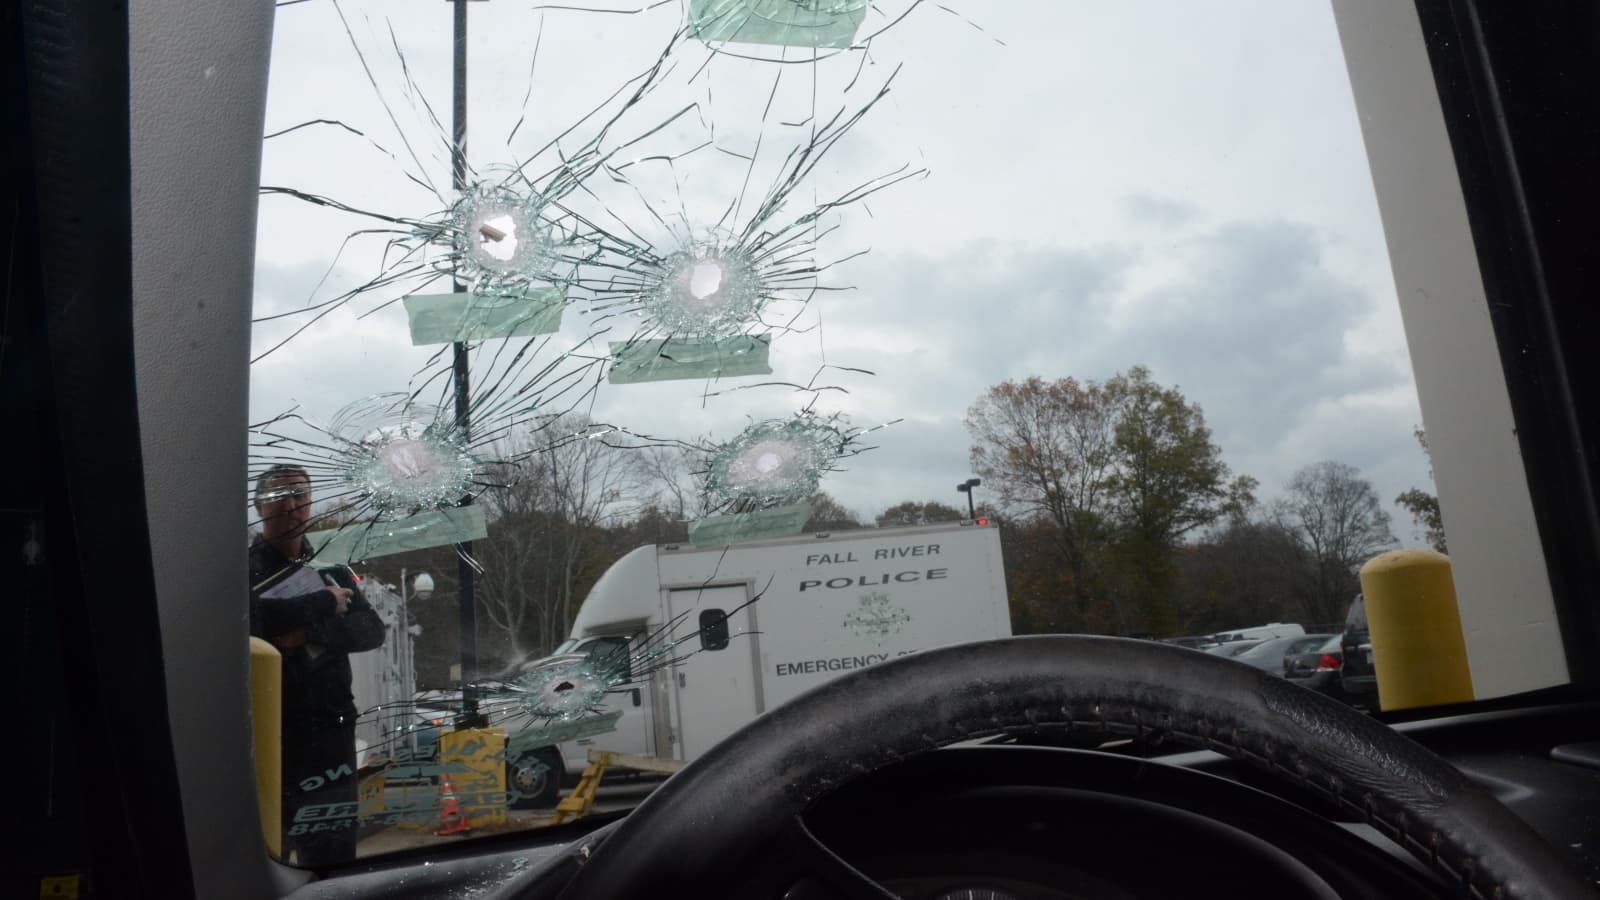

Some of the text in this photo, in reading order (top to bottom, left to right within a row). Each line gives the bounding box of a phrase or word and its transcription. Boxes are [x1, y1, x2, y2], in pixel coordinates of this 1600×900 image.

[806, 544, 941, 566] FALL RIVER
[799, 568, 948, 592] POLICE
